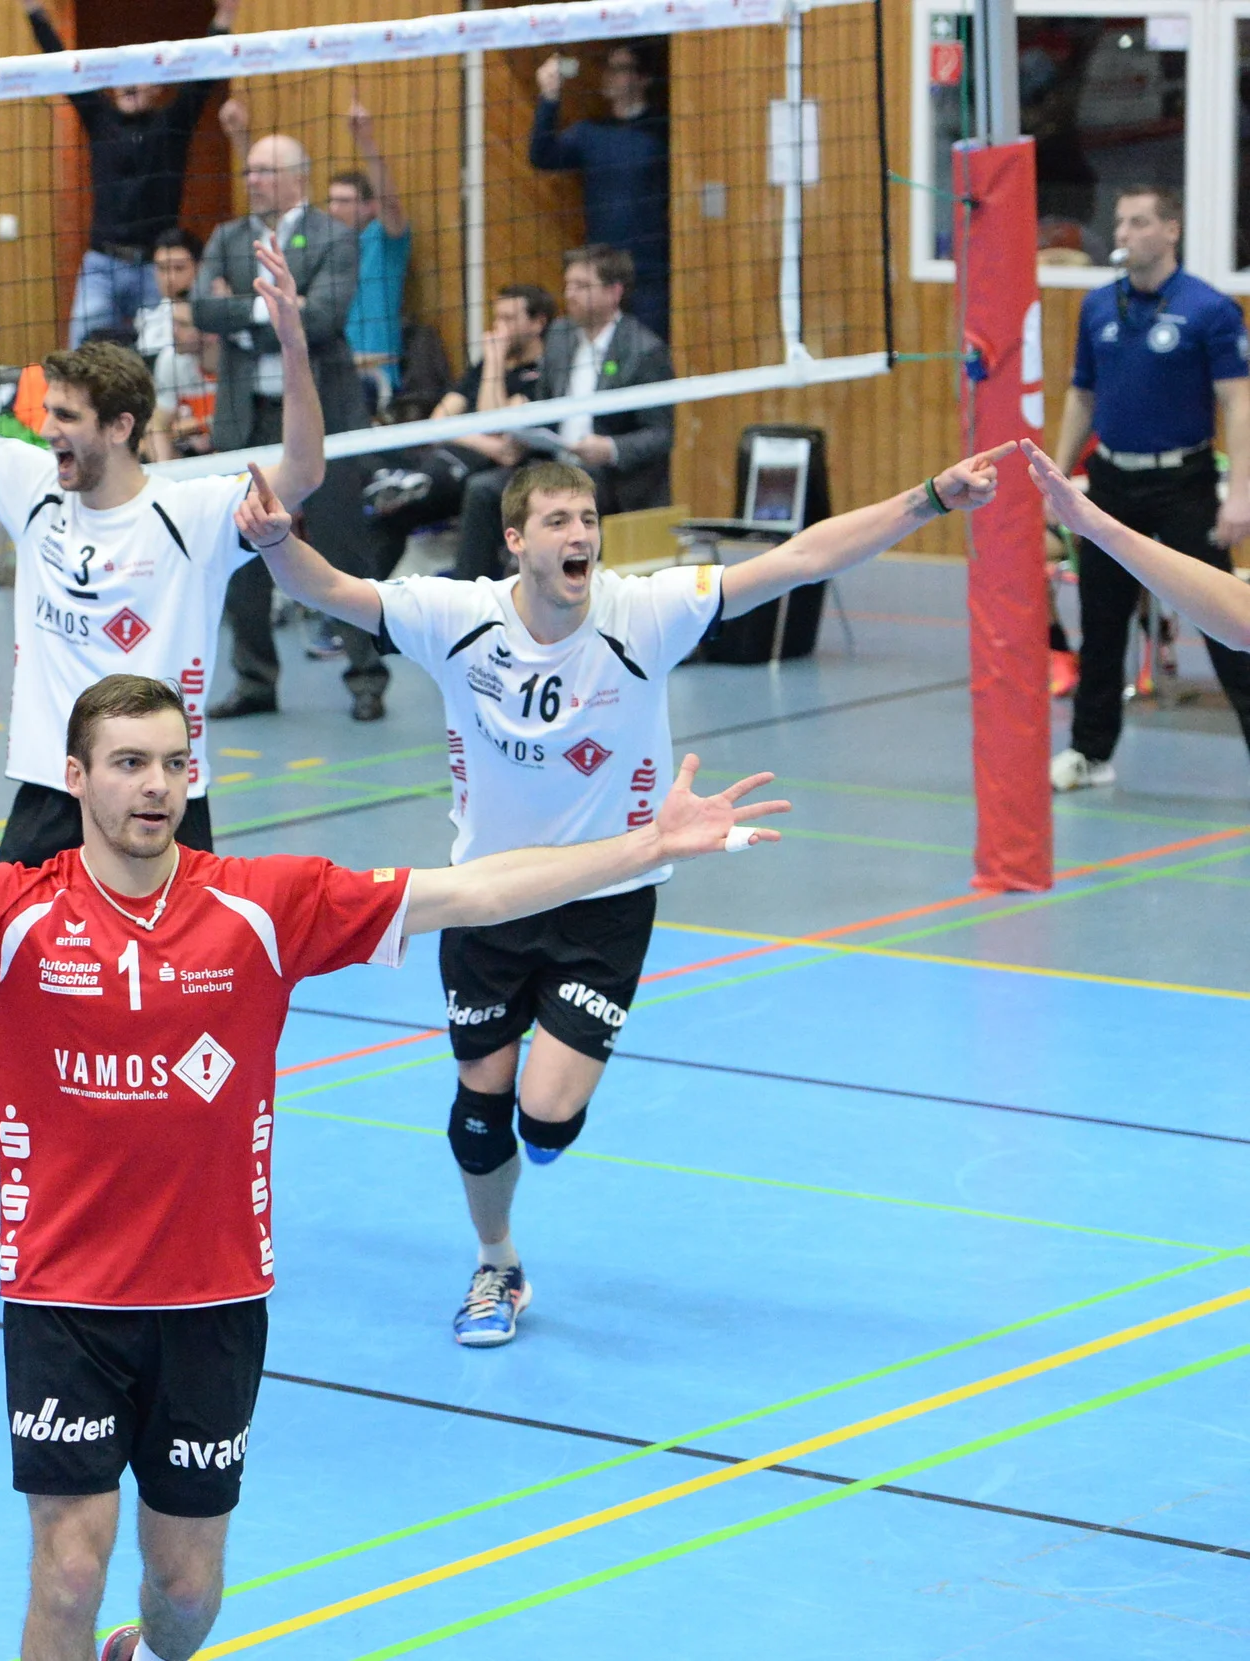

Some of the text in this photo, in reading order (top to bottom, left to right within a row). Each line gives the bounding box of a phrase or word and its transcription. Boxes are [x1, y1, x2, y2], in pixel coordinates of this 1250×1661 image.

[73, 545, 96, 586] 3
[519, 672, 562, 723] 16
[56, 936, 91, 946] erima
[38, 957, 102, 973] Autohaus
[41, 969, 99, 985] Plaschka
[118, 940, 142, 1011] 1
[180, 967, 234, 981] Sparkasse
[181, 981, 233, 994] Lüneburg
[54, 1048, 169, 1088] VAMOS
[59, 1085, 169, 1100] www.vamoskulturhalle.de
[12, 1397, 115, 1443] Mölders
